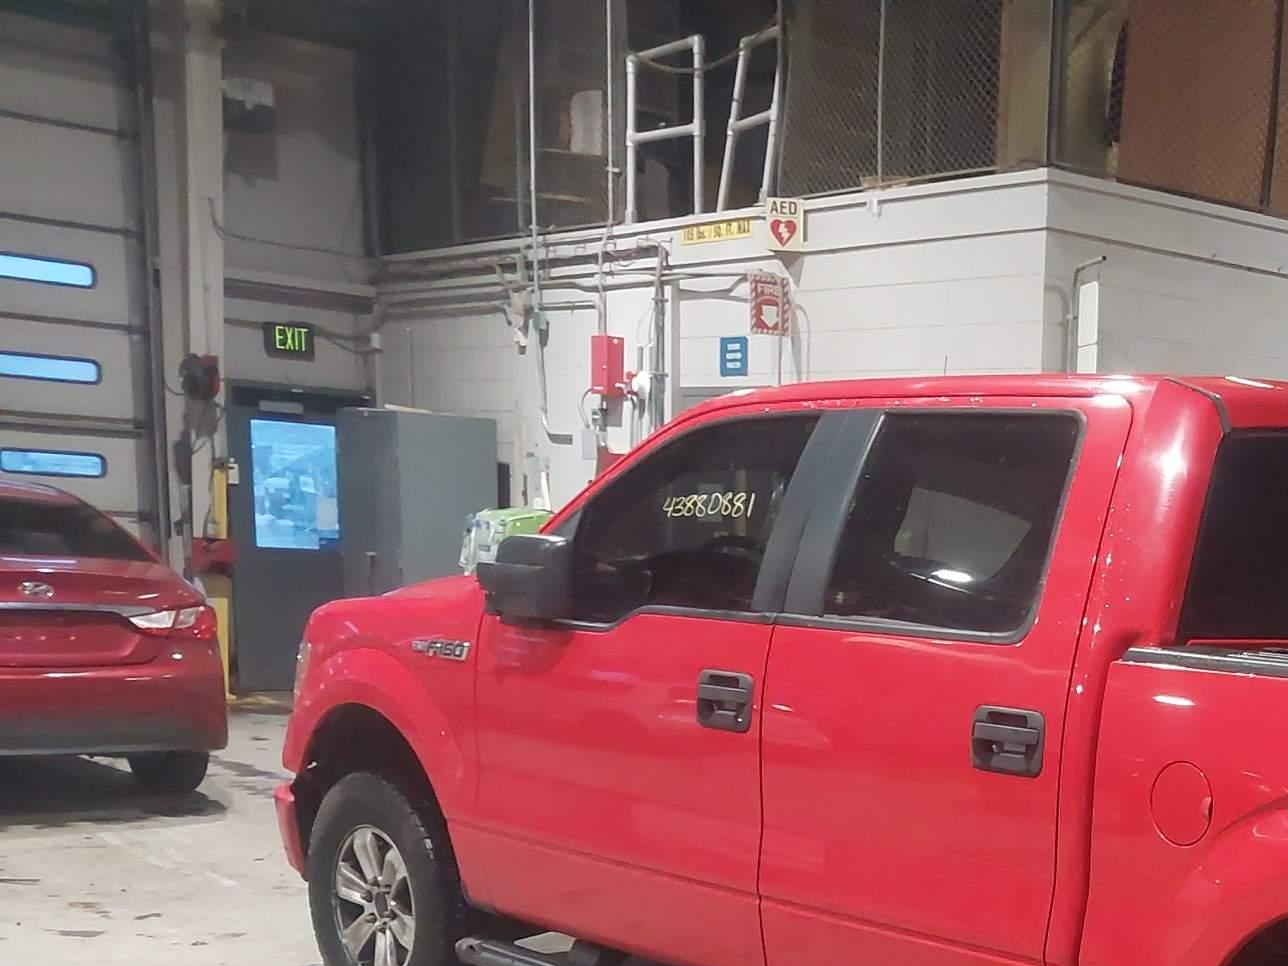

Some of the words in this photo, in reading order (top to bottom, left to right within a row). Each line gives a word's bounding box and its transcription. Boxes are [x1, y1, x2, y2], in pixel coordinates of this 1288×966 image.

[770, 201, 798, 215] AED
[275, 325, 309, 352] EXIT
[662, 491, 756, 518] 43880881
